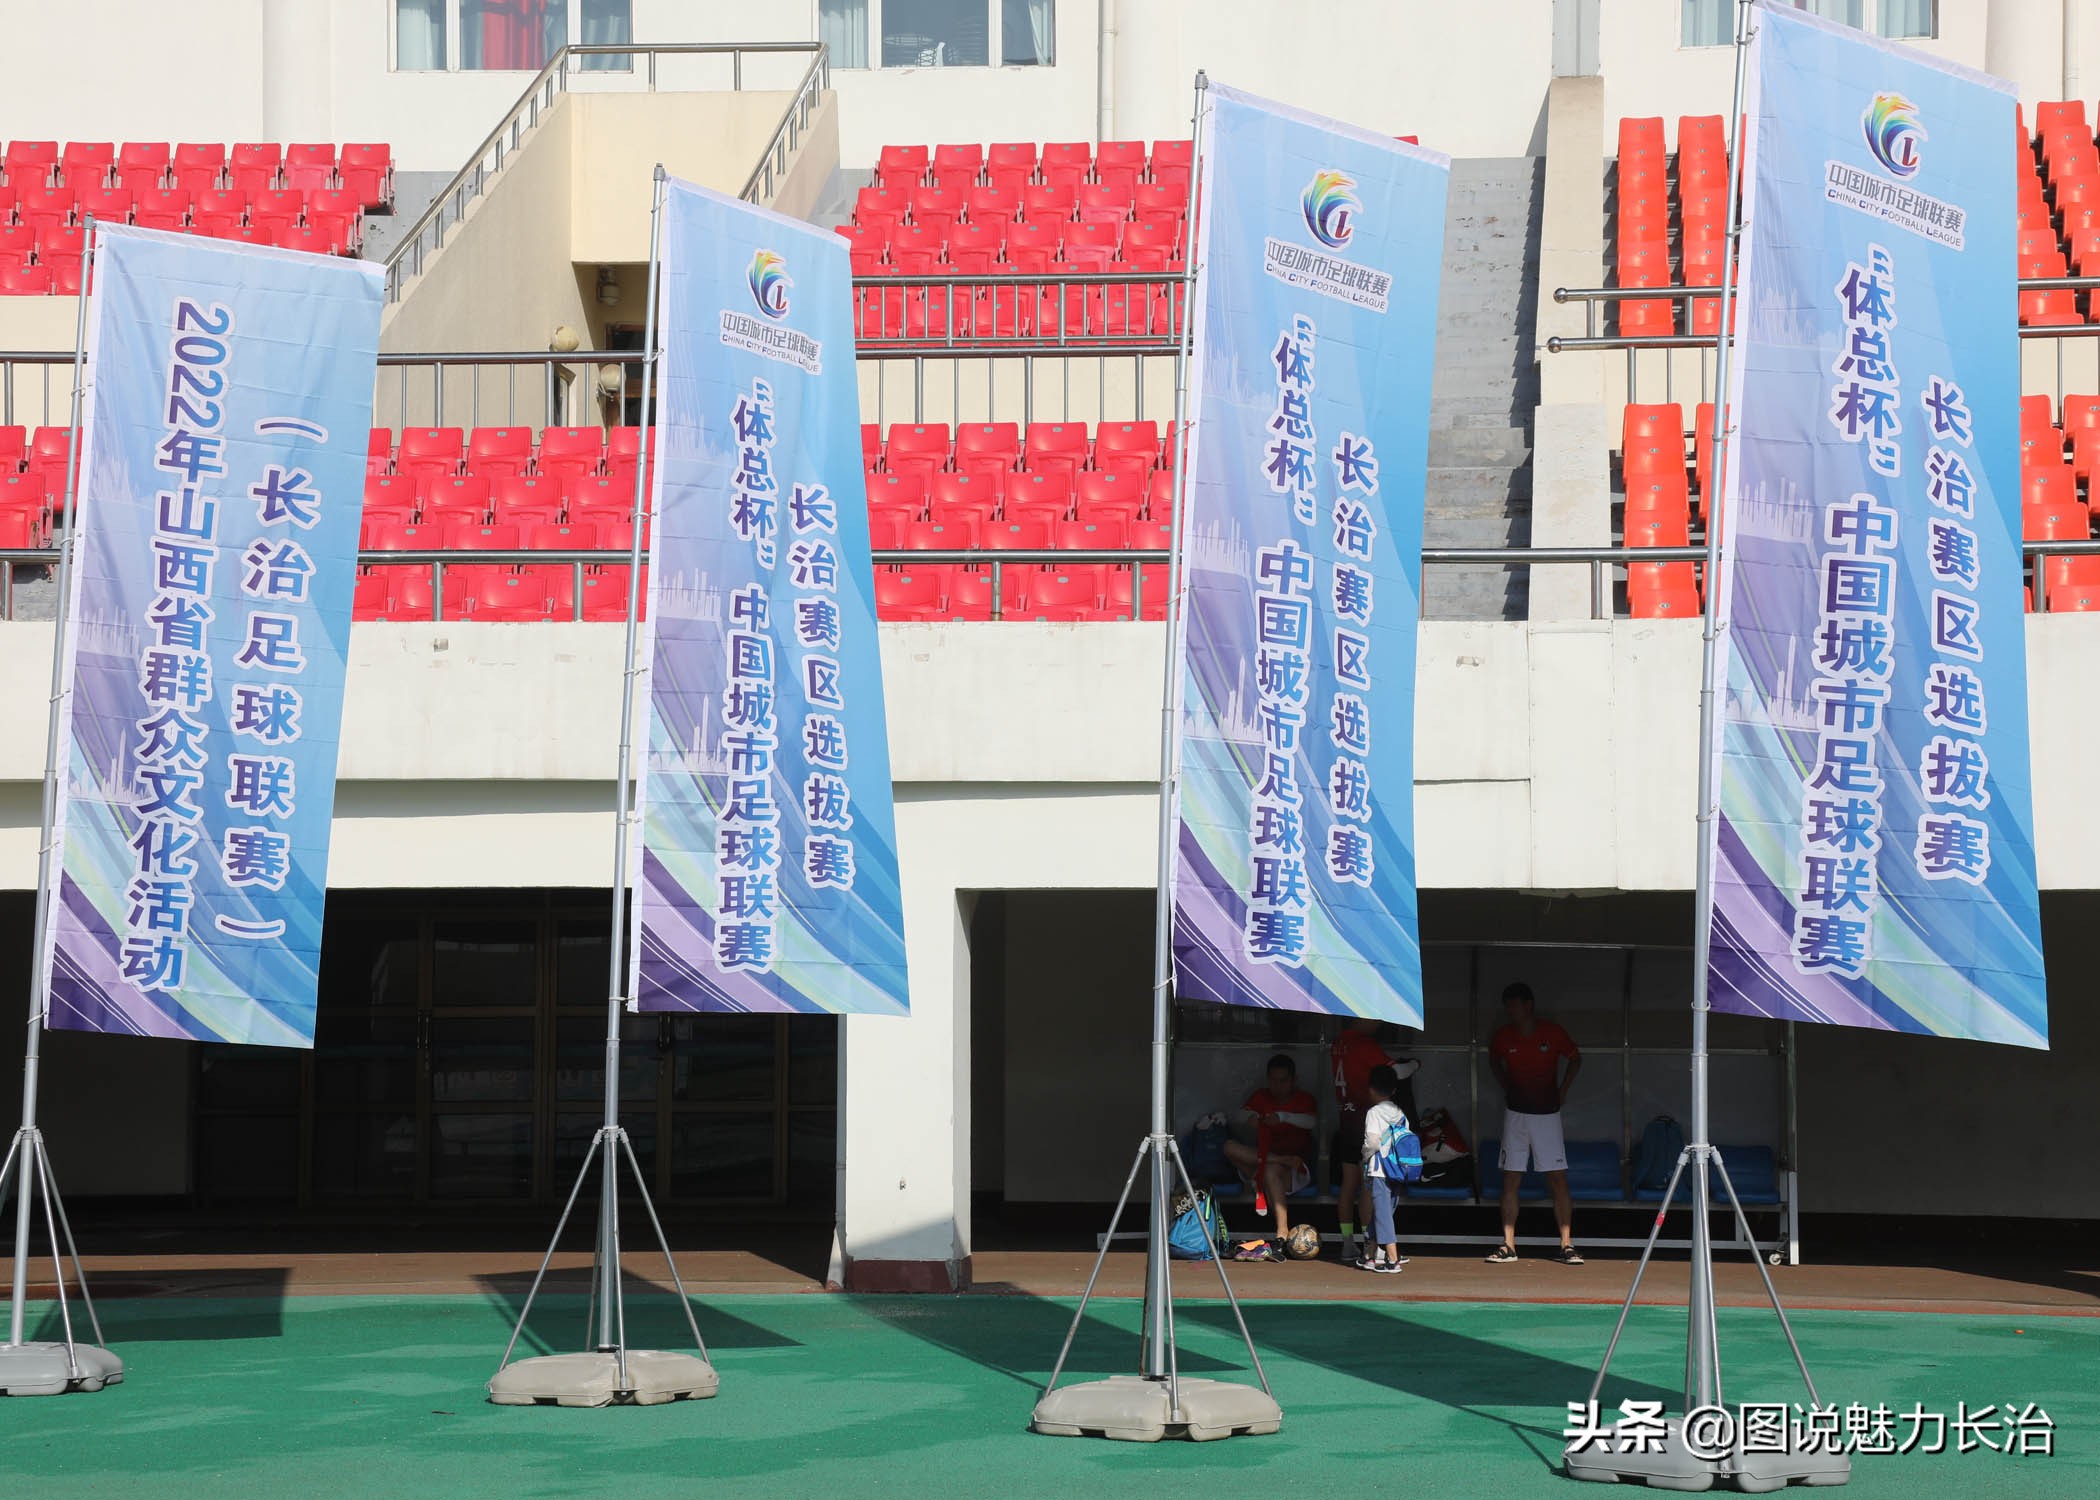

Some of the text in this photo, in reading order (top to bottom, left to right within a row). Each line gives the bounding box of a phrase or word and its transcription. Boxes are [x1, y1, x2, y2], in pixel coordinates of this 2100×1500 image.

[1828, 189, 1961, 247] CHINA CITY FOOTBALL LEAGUE
[1829, 164, 1963, 232] 中国城市足球联赛
[1268, 241, 1390, 297] 中国城市足球联赛
[1288, 273, 1308, 285] CITY
[1310, 279, 1350, 300] FOOTBALL
[1352, 293, 1385, 310] LEAGUE
[121, 300, 231, 990] 2022年山西省群众文化活动
[1331, 437, 1375, 883] 长治赛区选拔赛
[1922, 382, 1986, 880] 长治赛区选拔赛
[790, 486, 850, 885] 长治赛区选拔赛
[1335, 1059, 1346, 1097] 4
